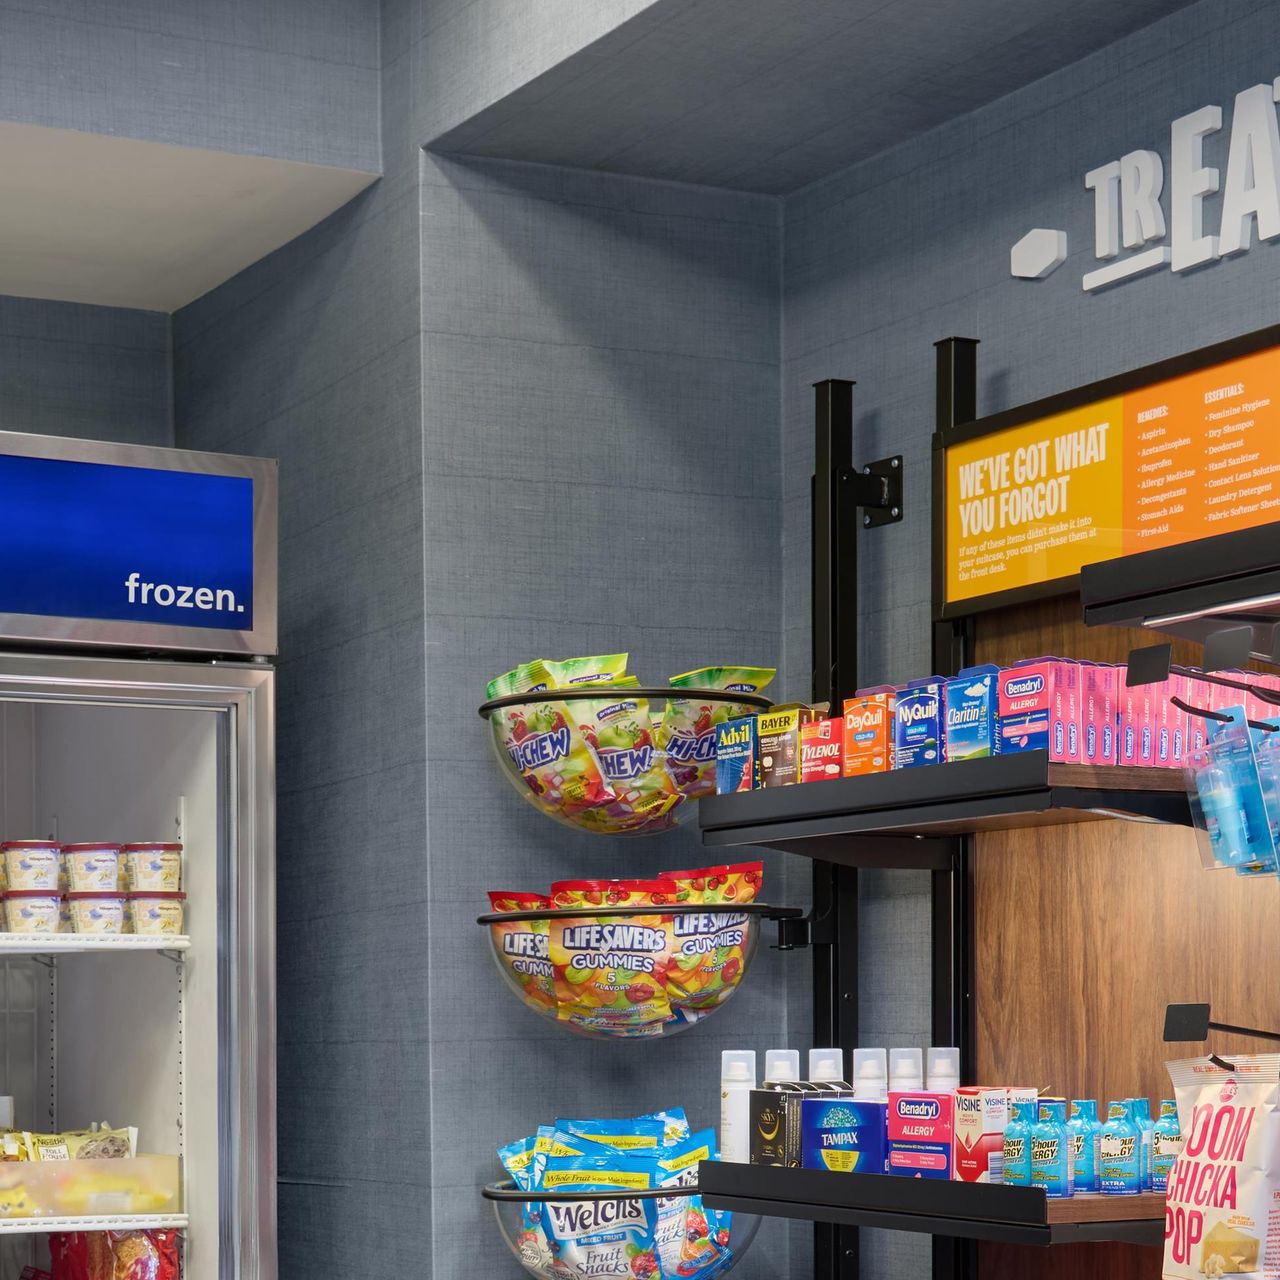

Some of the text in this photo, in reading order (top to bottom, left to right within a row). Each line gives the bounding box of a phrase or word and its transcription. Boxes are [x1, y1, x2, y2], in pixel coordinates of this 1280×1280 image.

[1204, 383, 1244, 404] ESSENTIALS:
[1137, 405, 1168, 424] REMEDIES:
[1209, 398, 1271, 421] Feminine Hygiene
[1141, 427, 1166, 440] Aspirin
[1209, 420, 1254, 438] Dry Shampoo
[1141, 437, 1191, 456] Acetaminophen
[1209, 438, 1244, 455] Deodorant
[959, 423, 1109, 500] WE'VE GOT WHAT
[1141, 459, 1172, 473] Ibuprofen
[1209, 452, 1260, 472] Hand Sanitizer
[1141, 469, 1196, 489] Allergy Medicine
[1209, 464, 1280, 488] Contact Lens Solution
[1141, 487, 1186, 504] Decongestants
[1209, 483, 1272, 505] Laundry Detergent
[959, 475, 1070, 538] YOU FORGOT
[1141, 504, 1184, 521] Stomach Aids
[1208, 509, 1229, 521] Fabric
[1230, 502, 1259, 517] Softener
[959, 516, 1092, 556] If any of these items didn't make it into
[959, 528, 1097, 571] your suitcase, you can purchase them at
[959, 570, 970, 581] the
[971, 565, 989, 578] front
[124, 573, 245, 613] frozen.
[761, 715, 791, 729] BAYER
[846, 710, 883, 730] DayQuil
[899, 702, 938, 726] NyQuil
[947, 706, 980, 726] Claritin
[719, 726, 750, 747] Advil
[802, 743, 840, 762] TYLENOL
[572, 954, 655, 972] GUMMIES
[595, 982, 631, 991] FLAVORS
[900, 1102, 937, 1116] Benadryl
[956, 1096, 981, 1112] VISINE
[821, 1132, 858, 1146] TAMPAX
[902, 1126, 934, 1136] ALLERGY
[580, 1233, 624, 1245] MIXED FRUIT
[586, 1249, 623, 1266] Fruit
[576, 1262, 629, 1275] Snacks
